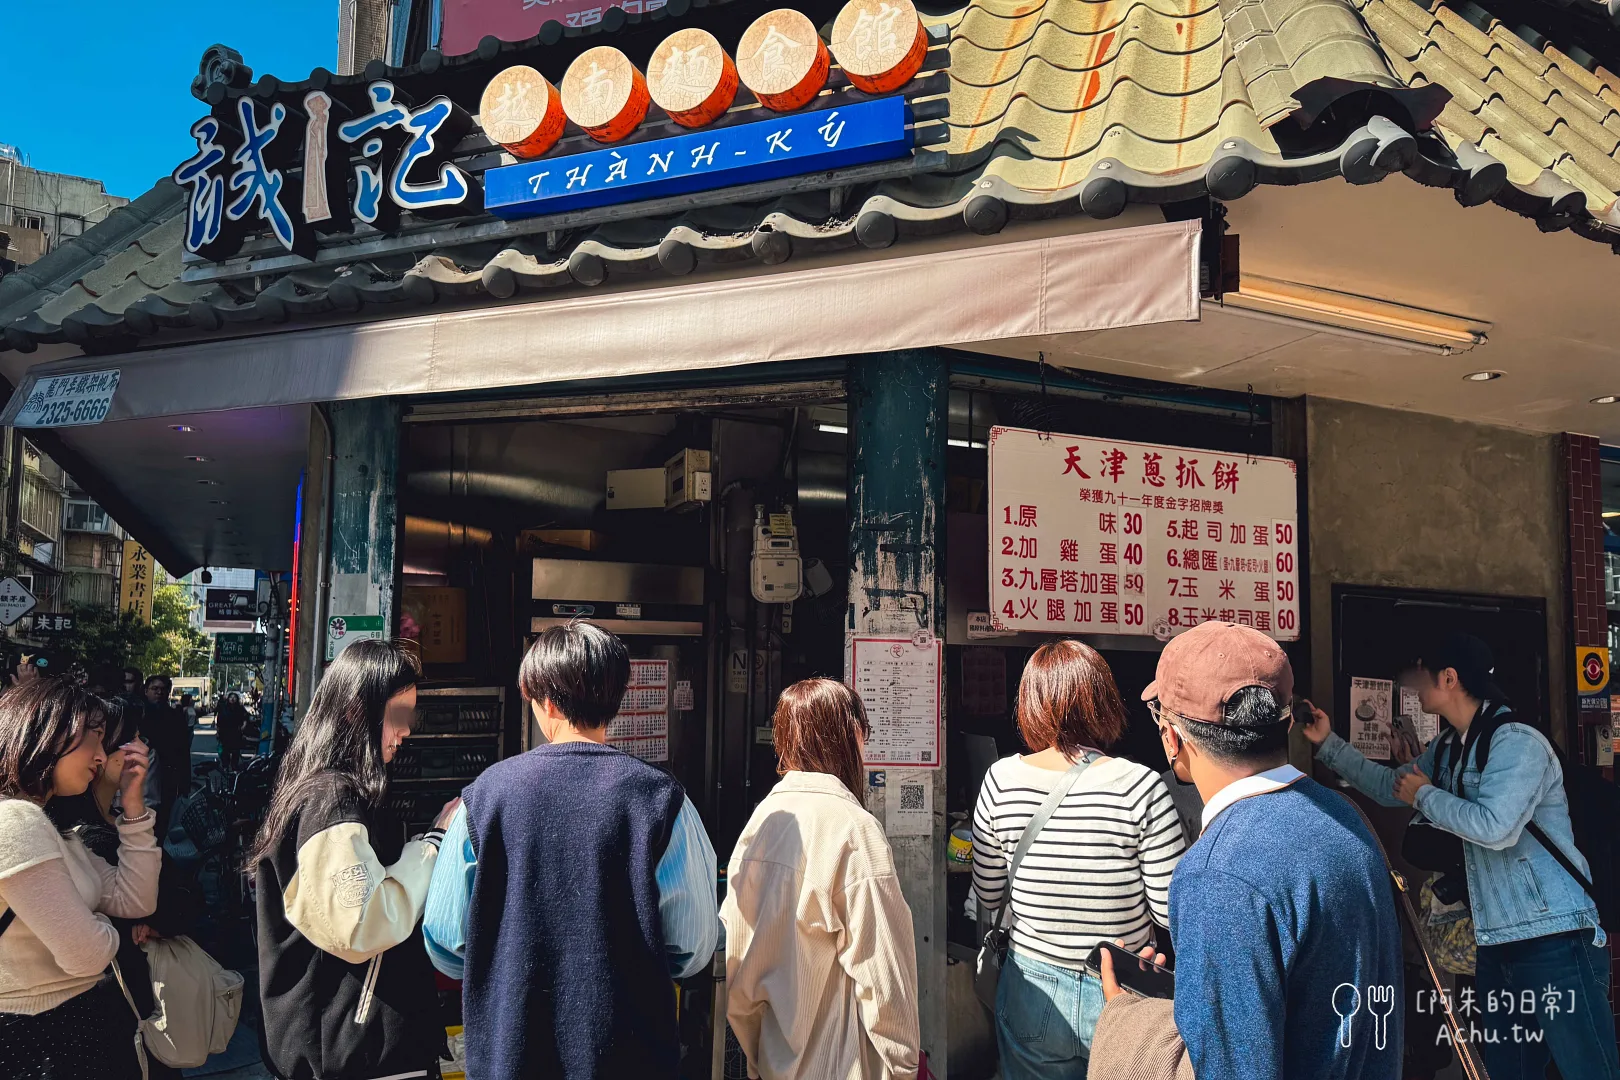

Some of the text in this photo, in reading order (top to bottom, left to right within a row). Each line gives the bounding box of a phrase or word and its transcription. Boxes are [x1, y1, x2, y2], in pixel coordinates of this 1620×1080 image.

[490, 2, 903, 127] 越南麵食館
[36, 397, 109, 425] 2325-6666
[1123, 512, 1143, 535] 30
[1275, 523, 1293, 545] 50
[1123, 543, 1143, 566] 40
[1276, 552, 1294, 573] 60
[1276, 580, 1294, 602] 50
[35, 615, 72, 630] 朱記
[1124, 603, 1144, 626] 50
[1277, 609, 1295, 630] 60
